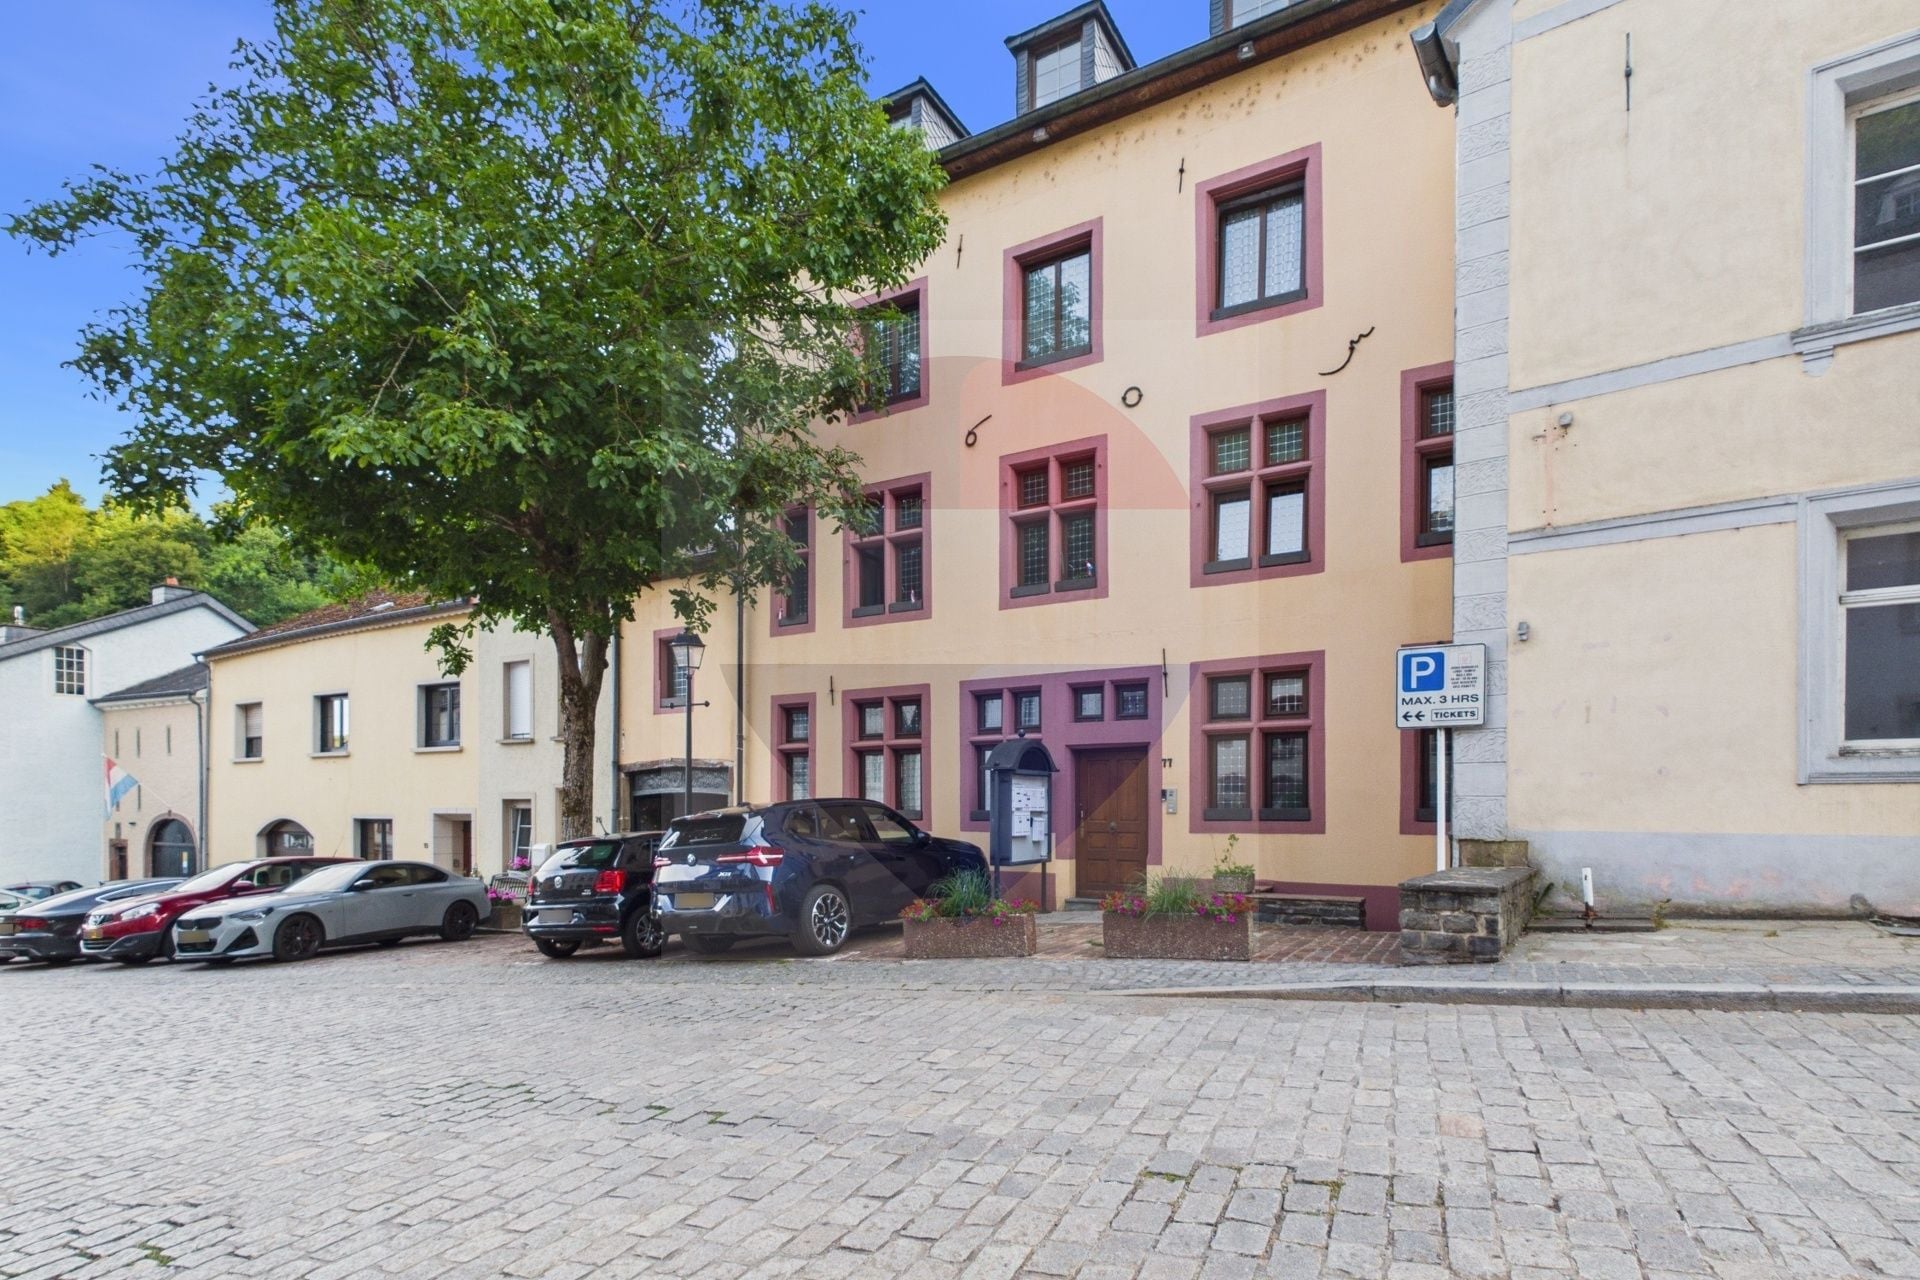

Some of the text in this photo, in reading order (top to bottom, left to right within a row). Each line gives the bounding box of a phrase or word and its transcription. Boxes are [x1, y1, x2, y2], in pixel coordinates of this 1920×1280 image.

[1410, 656, 1436, 689] P
[1402, 694, 1479, 706] MAX. 3 HRS
[1434, 710, 1476, 719] TICKETS
[1161, 758, 1173, 768] 77
